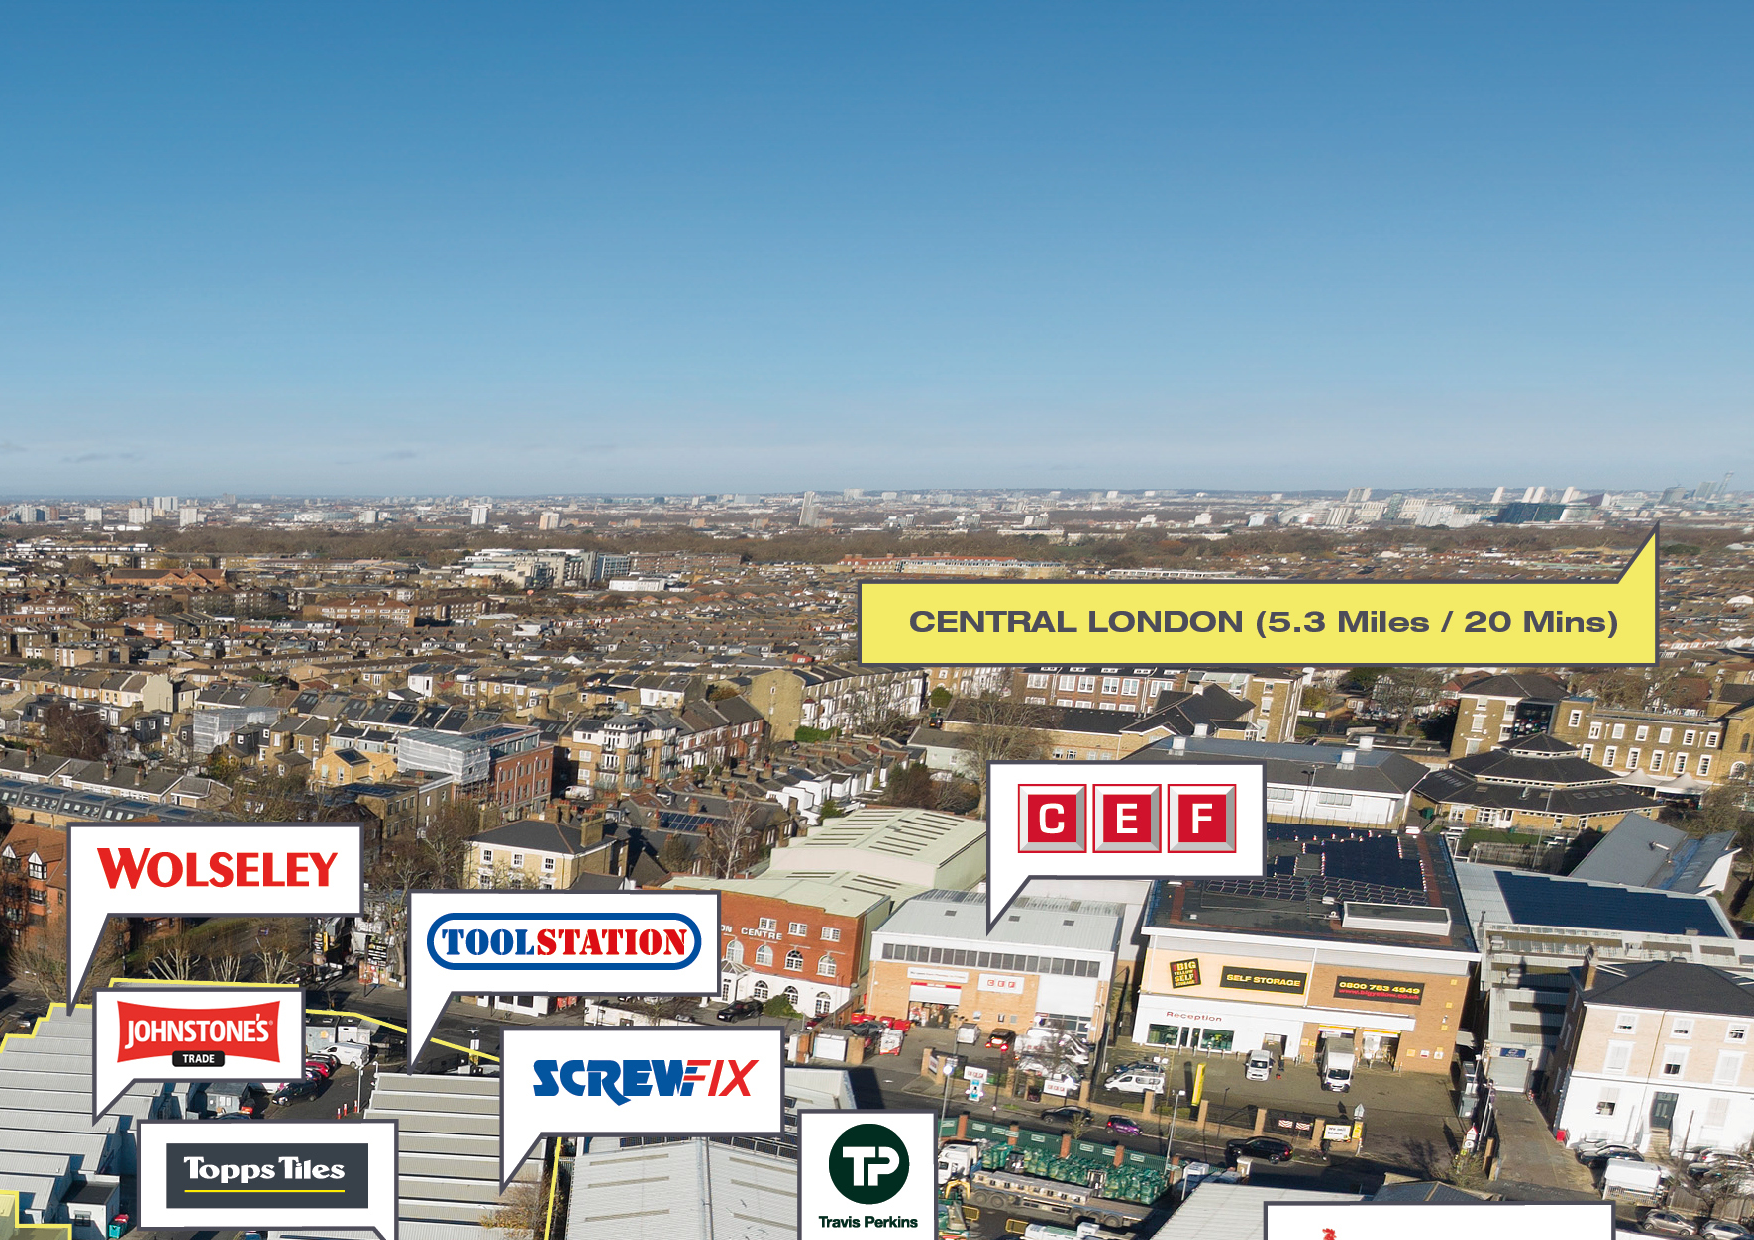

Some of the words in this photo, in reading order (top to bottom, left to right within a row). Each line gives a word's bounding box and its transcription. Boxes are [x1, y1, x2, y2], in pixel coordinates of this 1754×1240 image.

[740, 926, 783, 942] CENTRE
[1175, 960, 1197, 972] BIG
[1174, 973, 1195, 983] SELF
[1226, 973, 1252, 984] SELF
[1253, 976, 1301, 987] STORAGE
[1338, 981, 1368, 990] 0800
[1391, 986, 1421, 995] 4949
[1166, 1011, 1223, 1023] Reception
